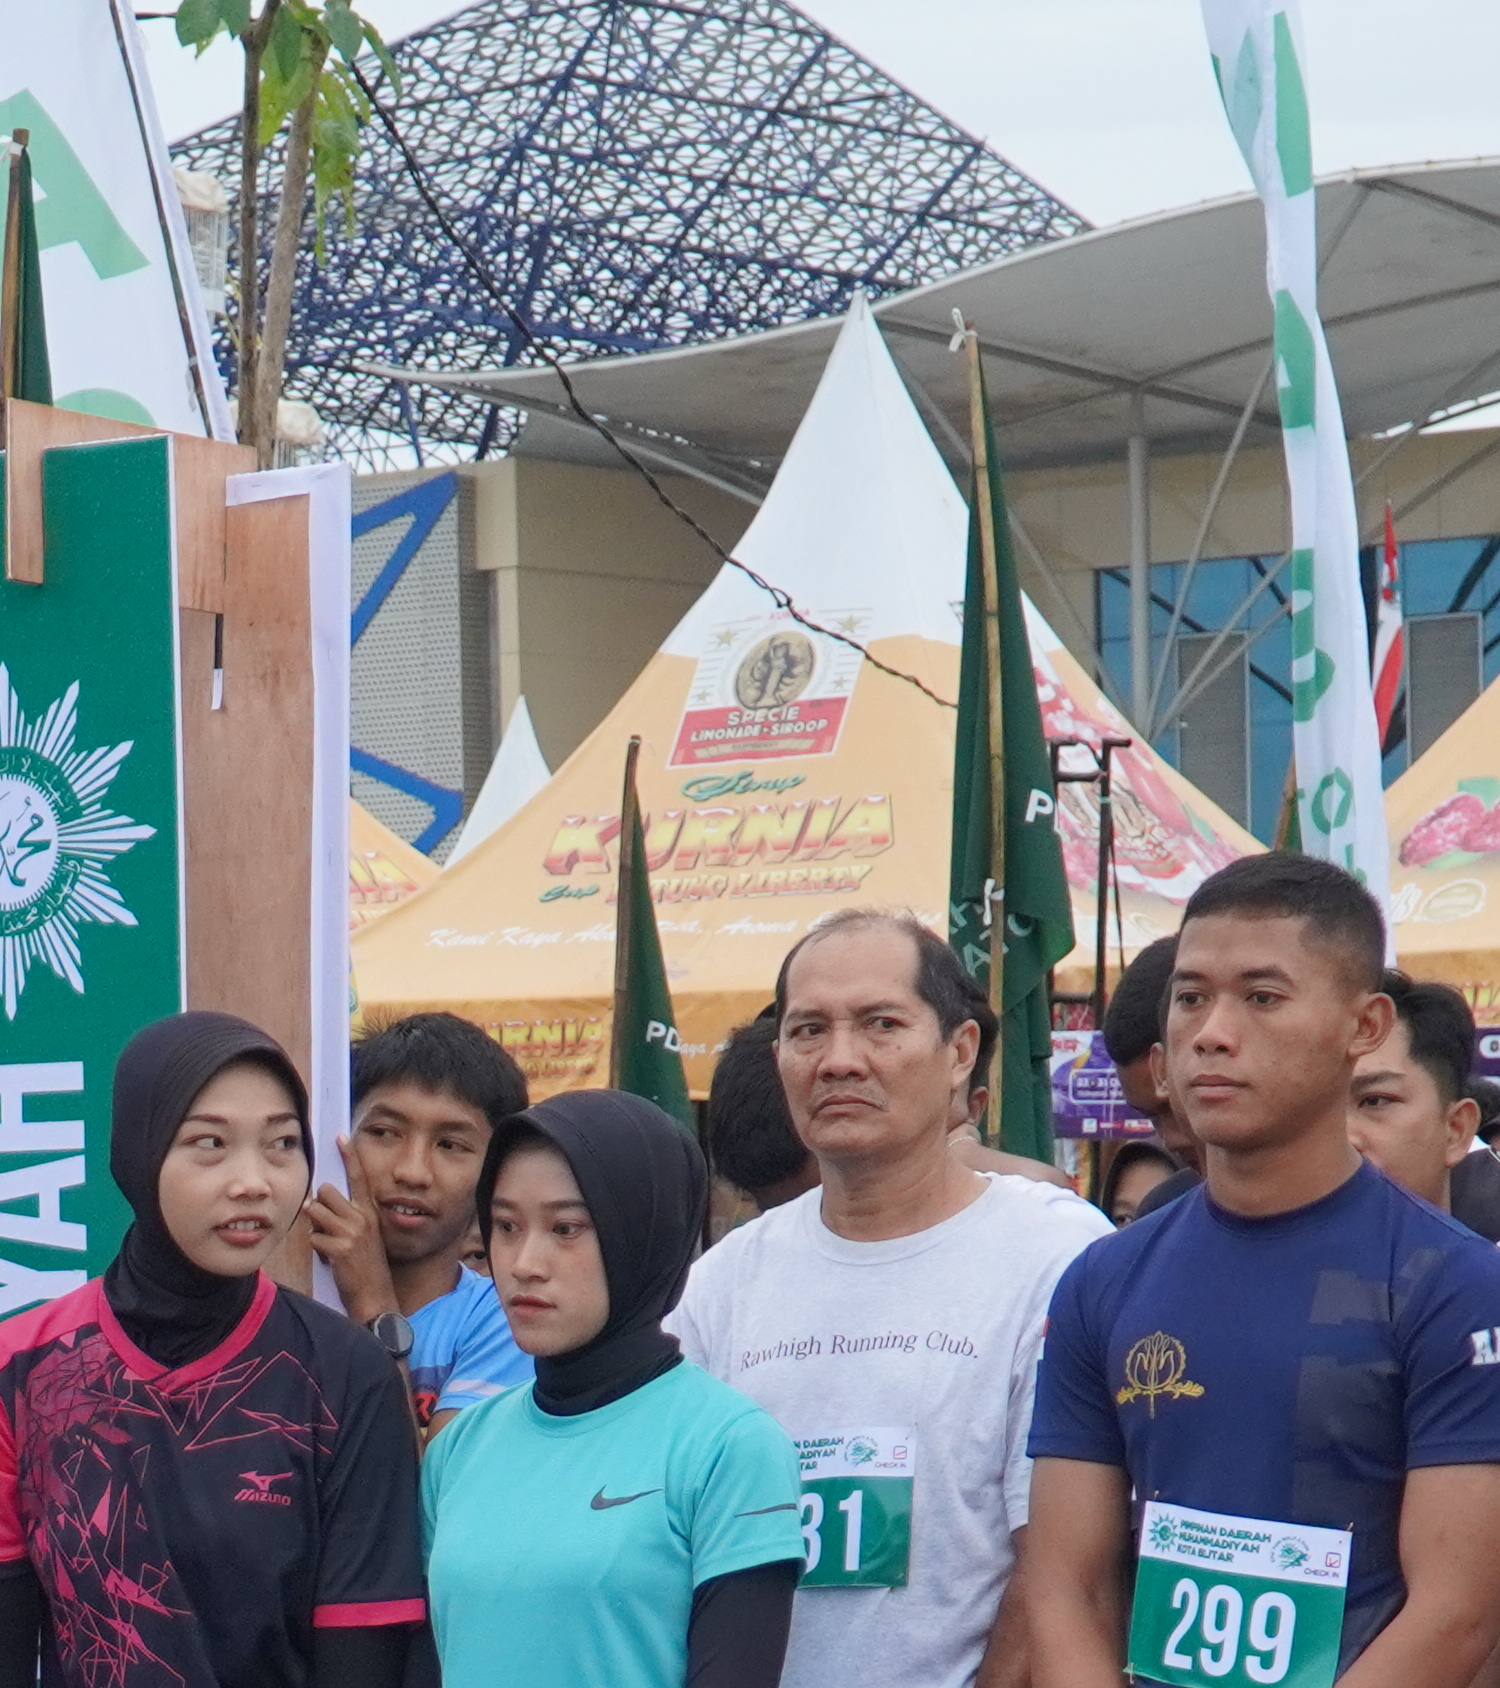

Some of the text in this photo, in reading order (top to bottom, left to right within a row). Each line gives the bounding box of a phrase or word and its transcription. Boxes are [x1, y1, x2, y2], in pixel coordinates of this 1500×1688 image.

[727, 708, 800, 726] SPECIE
[740, 1329, 979, 1372] Rawhigh Running Club.
[1177, 1531, 1261, 1554] MUHAMMADIYAH
[1219, 1525, 1273, 1544] DAERAH
[1176, 1544, 1198, 1558] KOTA
[1164, 1577, 1297, 1685] 299
